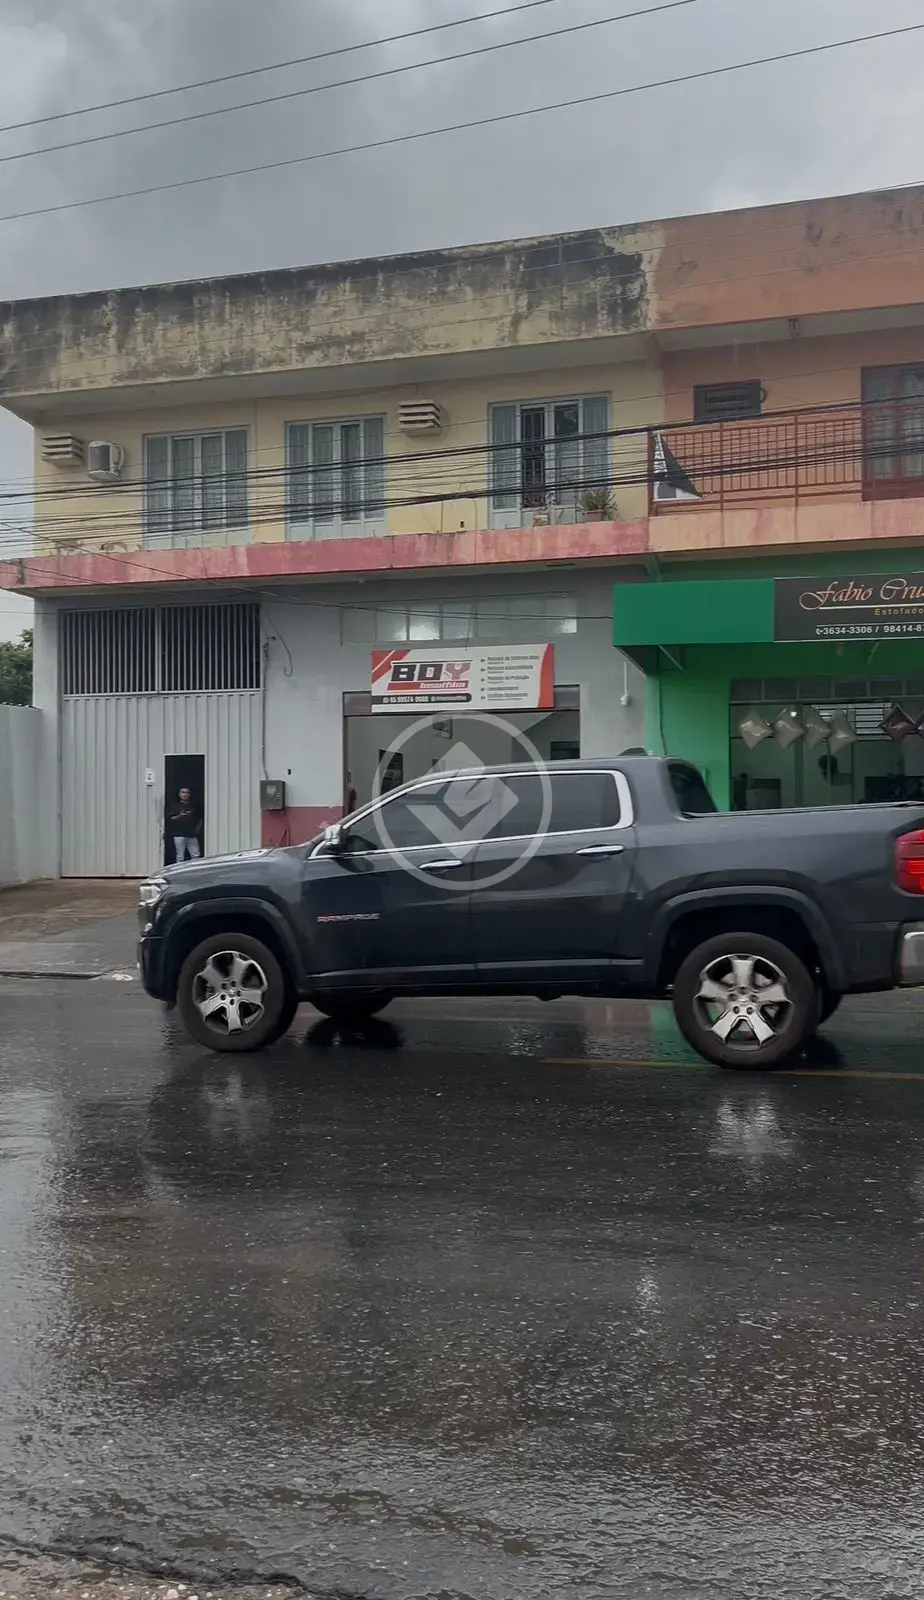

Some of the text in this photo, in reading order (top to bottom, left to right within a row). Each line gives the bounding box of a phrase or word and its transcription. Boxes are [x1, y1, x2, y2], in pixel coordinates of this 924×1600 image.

[799, 578, 924, 610] Fabio Cru
[391, 663, 471, 681] BOY
